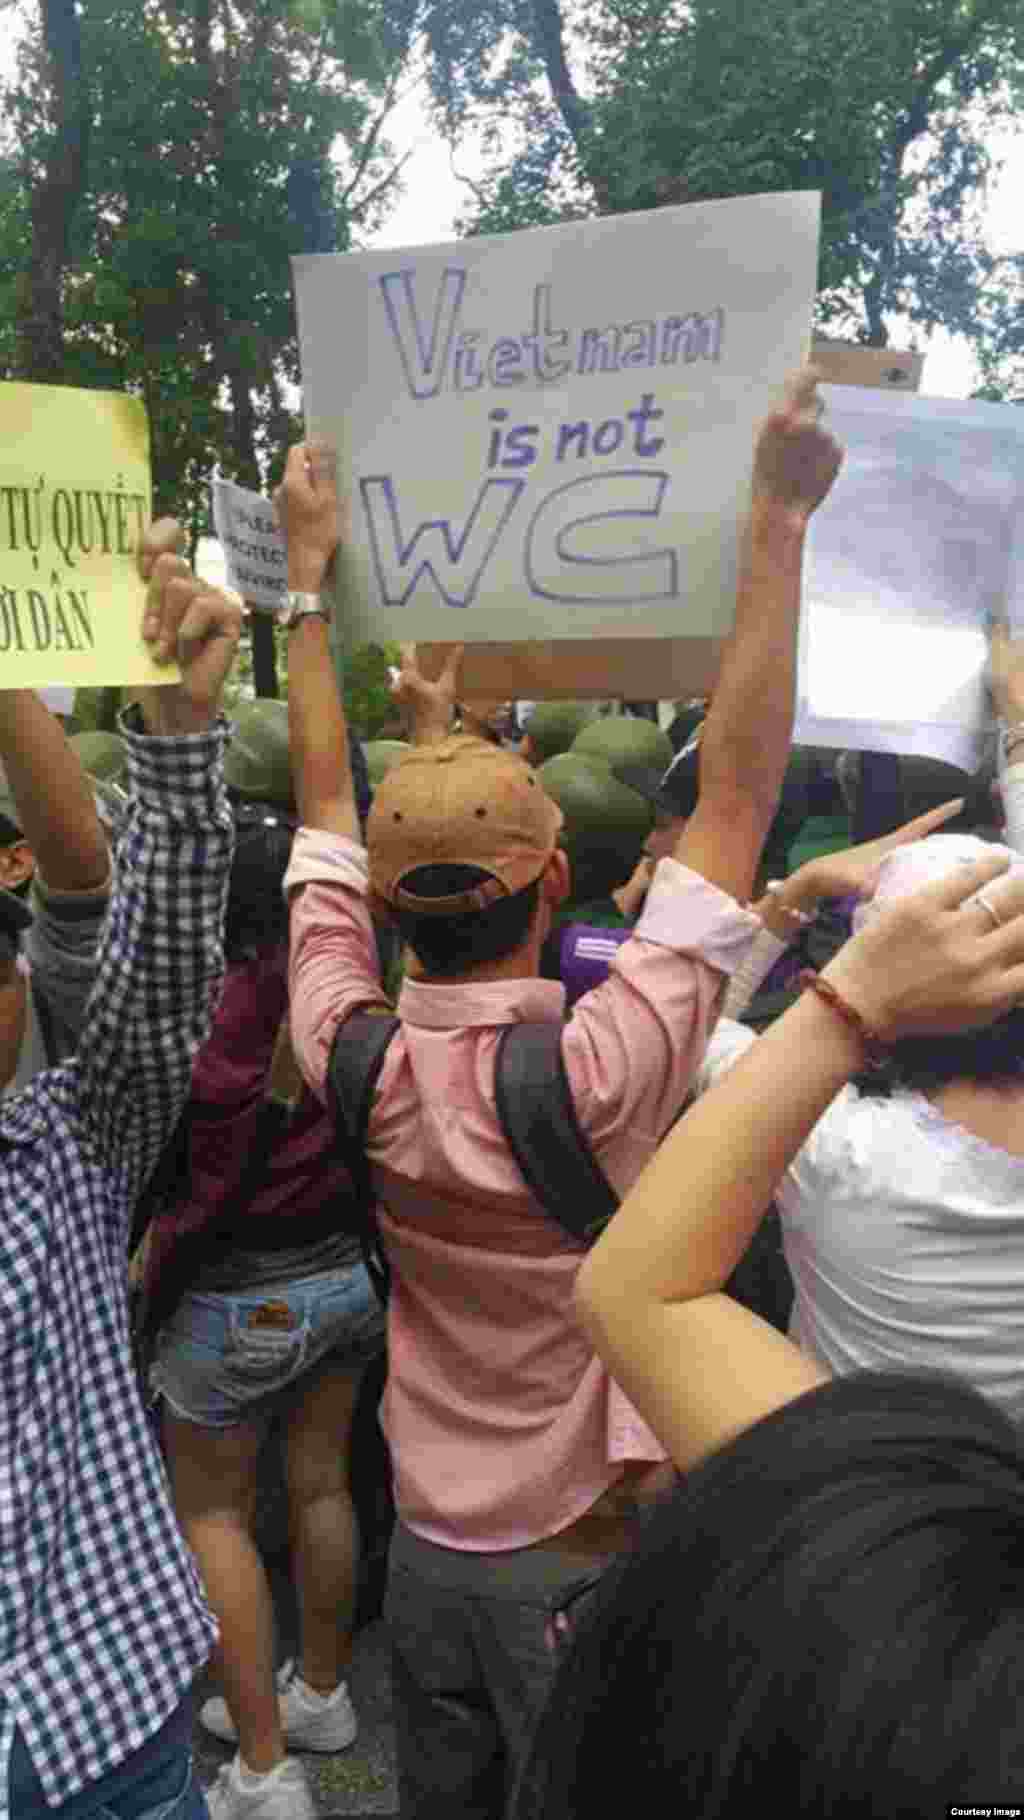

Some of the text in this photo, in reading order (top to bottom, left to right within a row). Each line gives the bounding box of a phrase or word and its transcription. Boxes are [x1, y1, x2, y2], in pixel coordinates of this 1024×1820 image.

[378, 267, 724, 400] Vietnam
[487, 393, 664, 469] is not
[359, 470, 678, 607] WC
